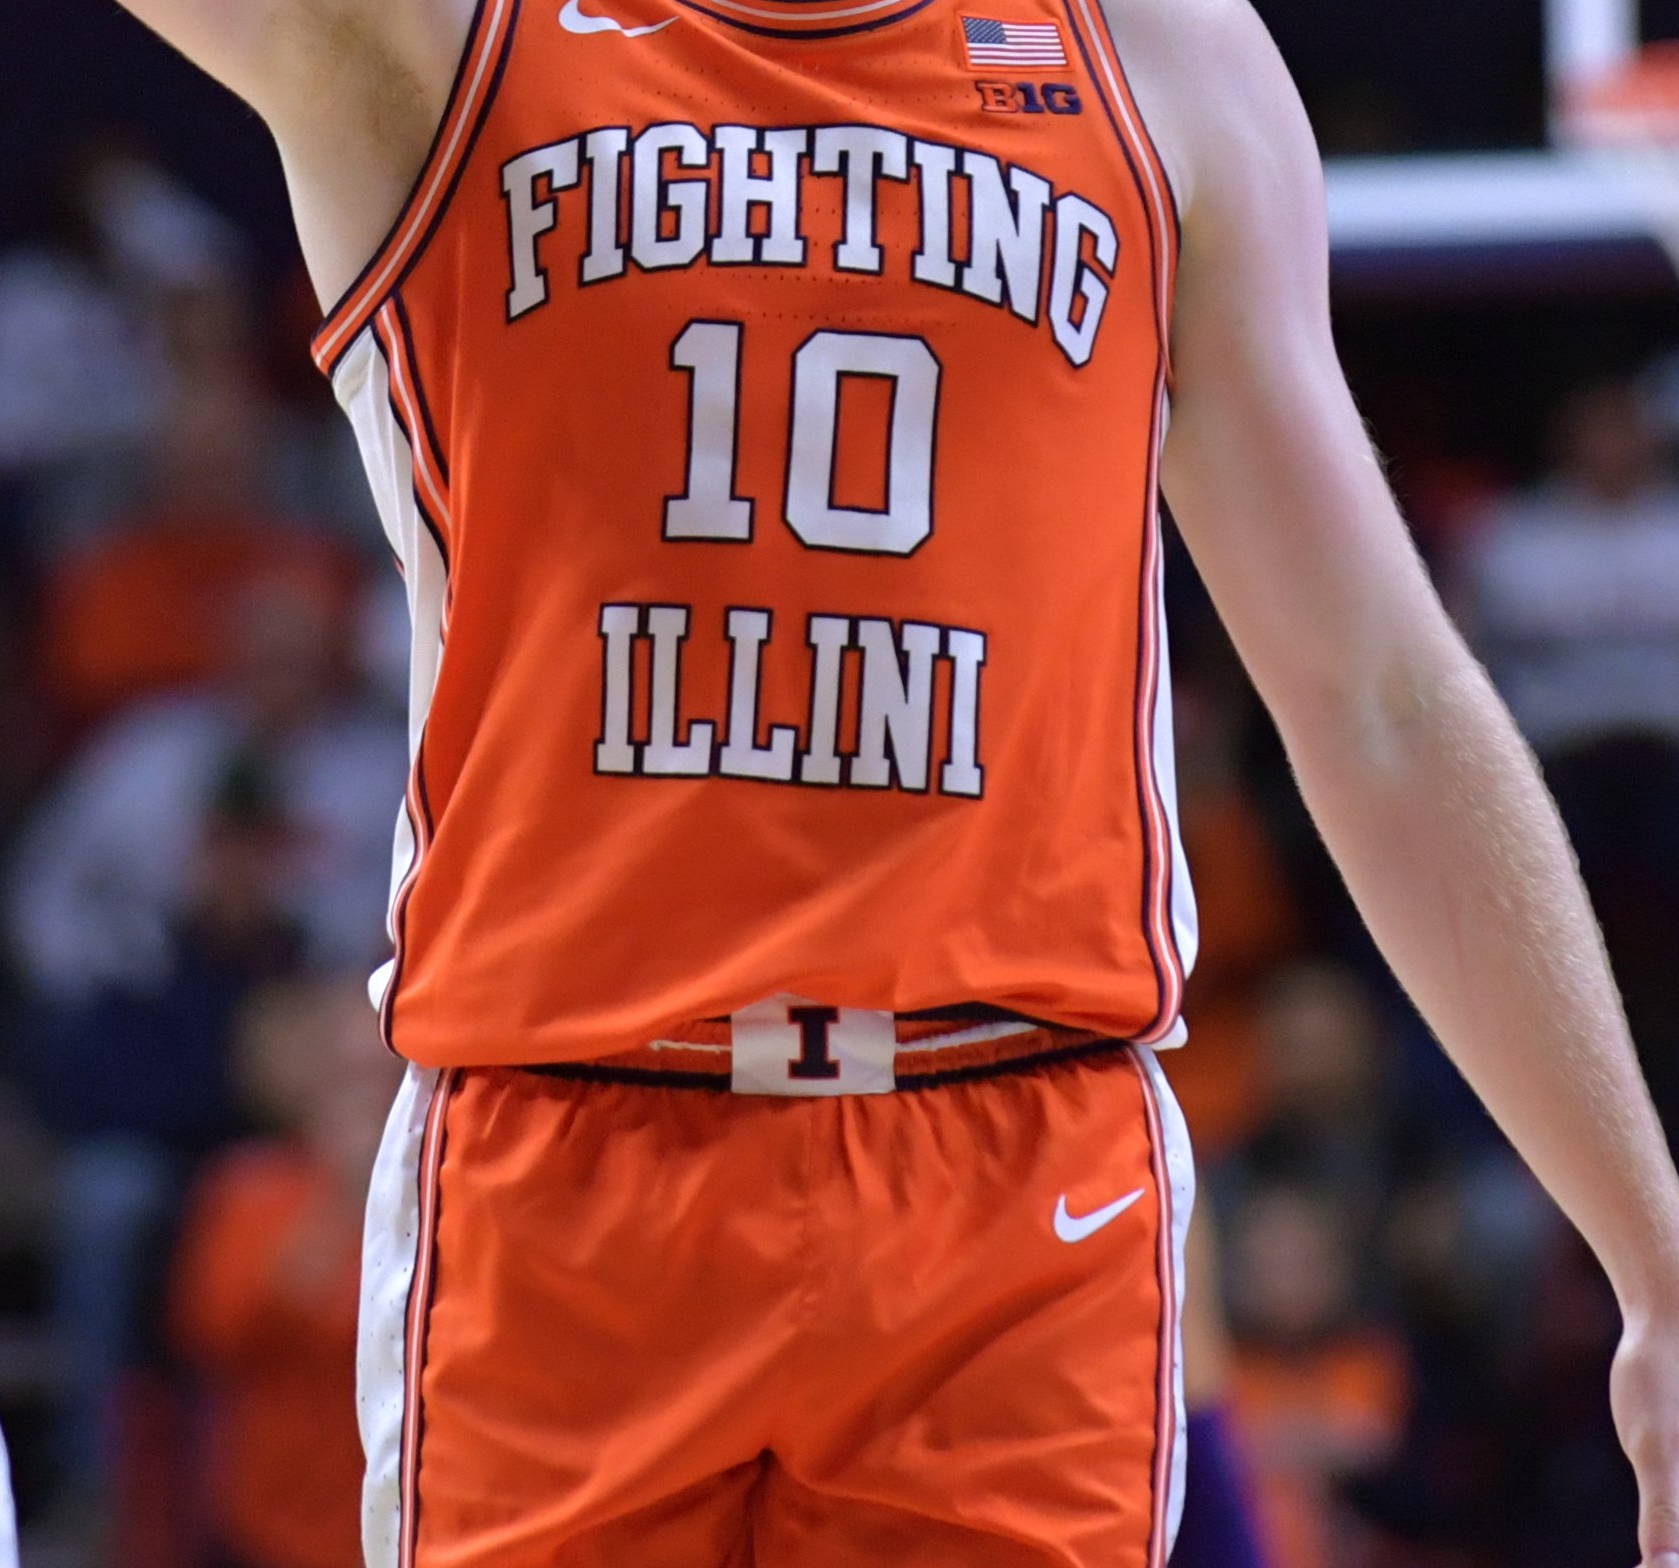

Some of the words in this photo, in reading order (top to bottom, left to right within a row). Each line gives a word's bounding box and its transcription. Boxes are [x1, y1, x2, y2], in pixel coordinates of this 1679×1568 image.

[500, 122, 1119, 368] FIGHTING
[660, 317, 942, 557] 10
[593, 602, 987, 800] ILLINI
[787, 1006, 841, 1080] I
